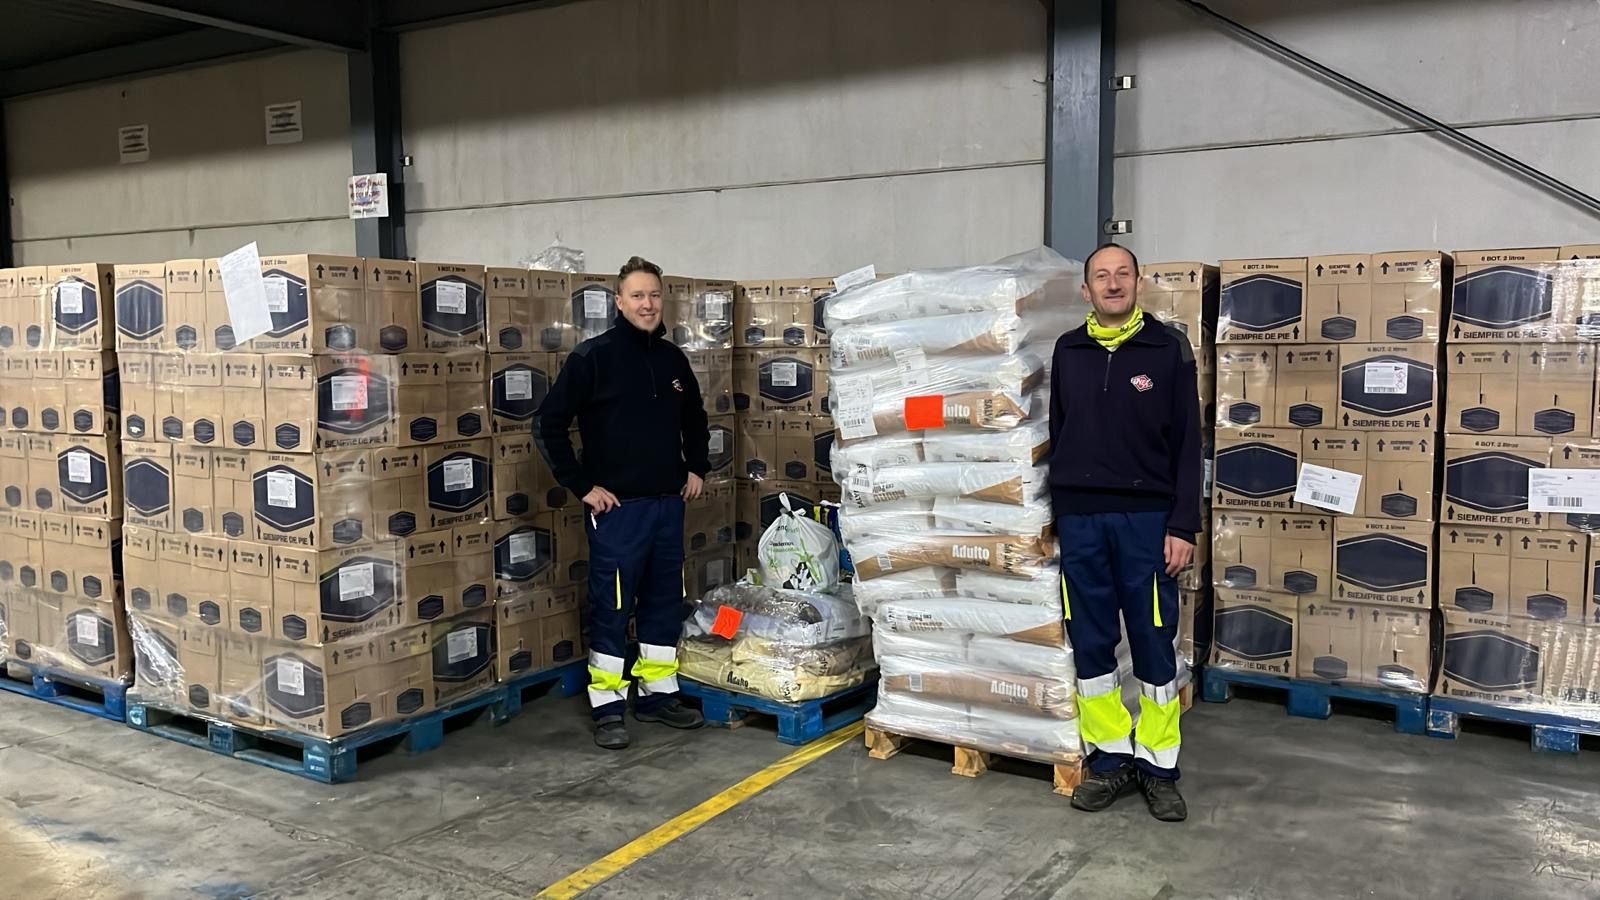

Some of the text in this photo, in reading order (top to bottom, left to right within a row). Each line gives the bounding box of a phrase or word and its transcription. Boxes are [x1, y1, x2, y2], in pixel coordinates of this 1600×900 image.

[1463, 331, 1506, 339] SIEMPRE
[1406, 420, 1421, 428] PIE
[1225, 499, 1260, 507] SIEMPRE
[1273, 500, 1286, 508] PIE
[1457, 513, 1530, 524] SIEMPRE DE PIE
[263, 533, 308, 545] SIEMPRE DE PIE
[952, 544, 990, 559] Adulto
[1347, 592, 1385, 600] SIEMPRE
[1400, 595, 1415, 603] PIE
[990, 680, 1028, 698] Adulto
